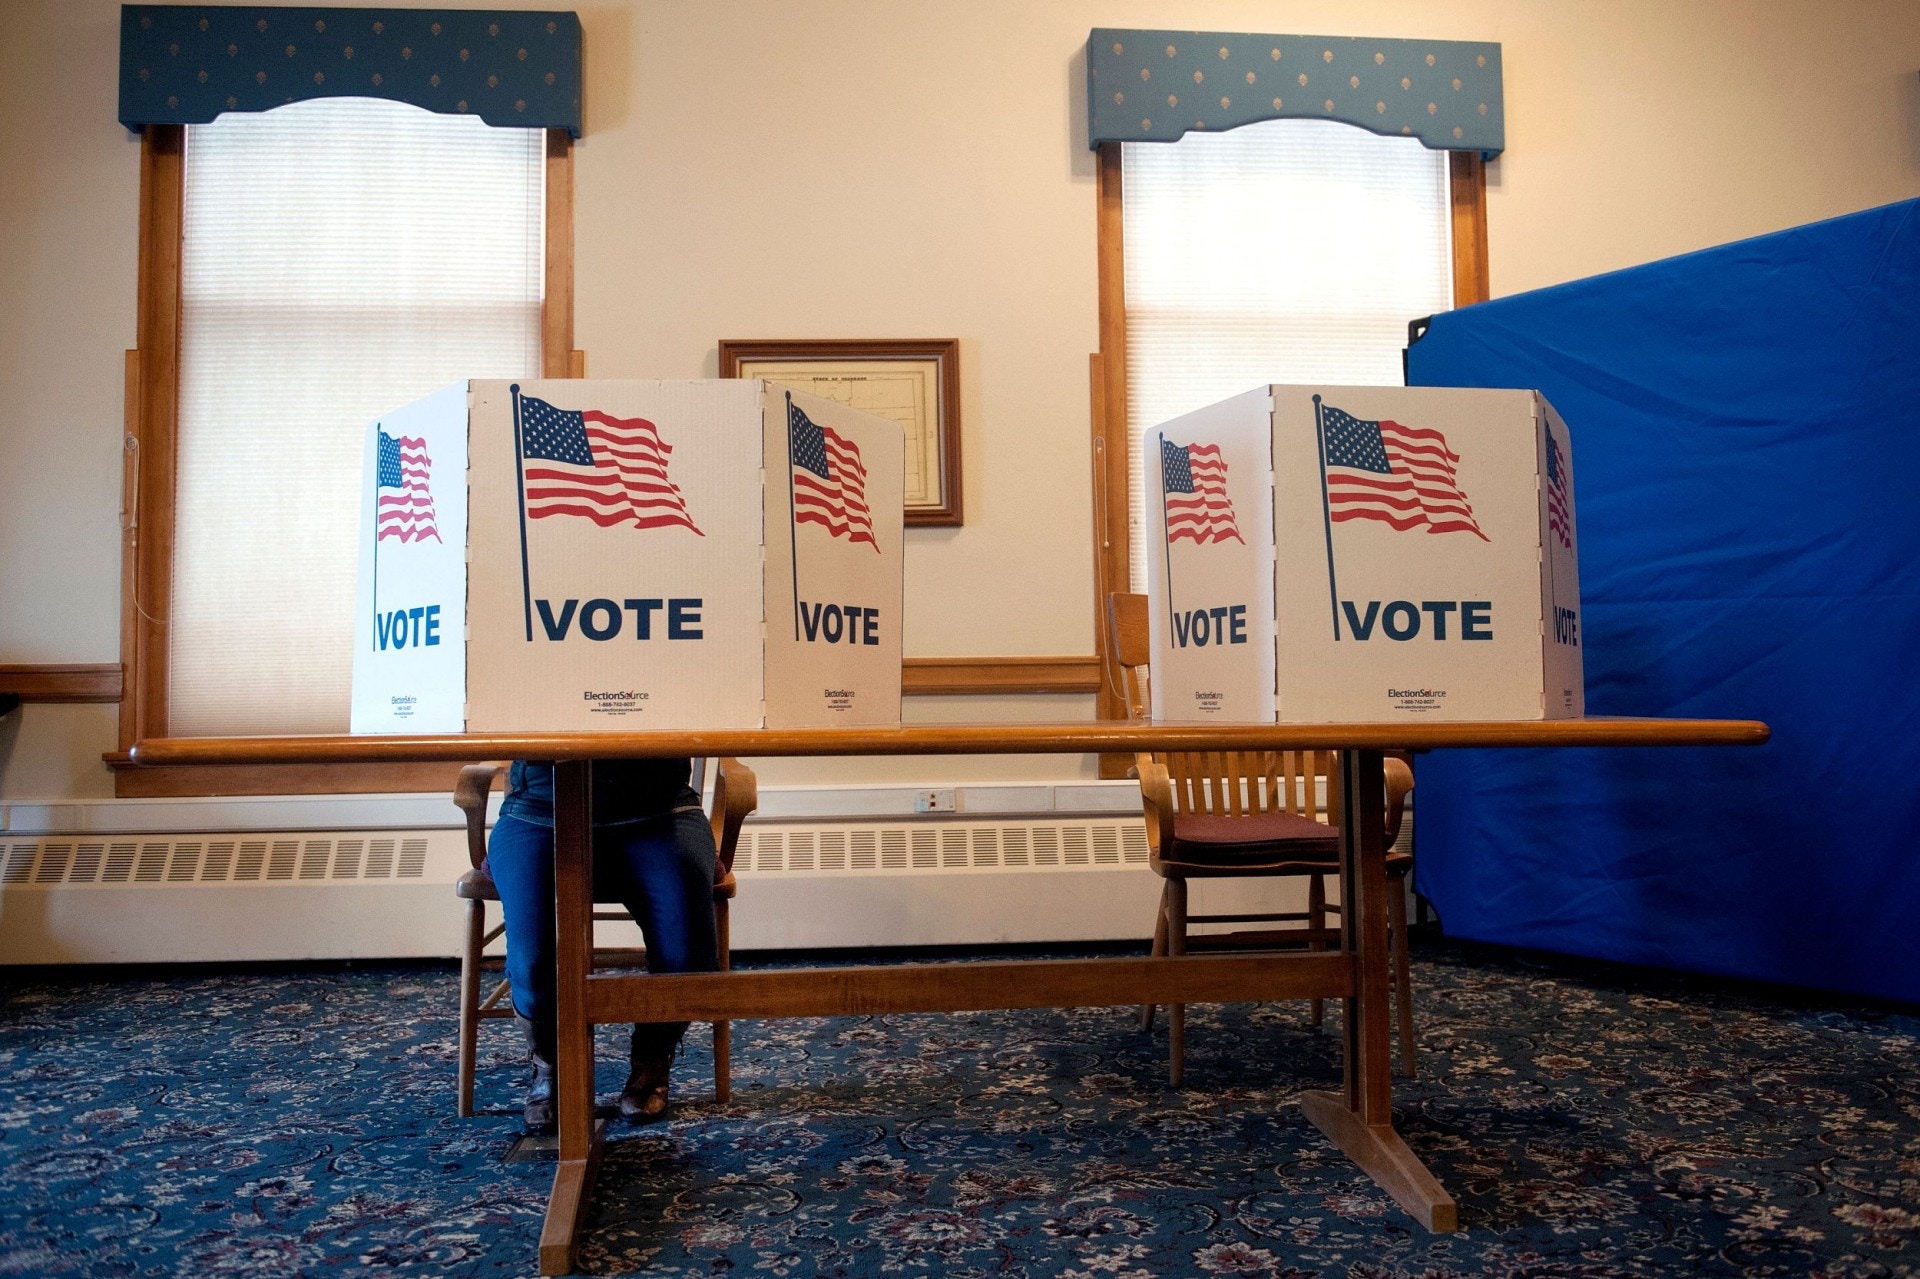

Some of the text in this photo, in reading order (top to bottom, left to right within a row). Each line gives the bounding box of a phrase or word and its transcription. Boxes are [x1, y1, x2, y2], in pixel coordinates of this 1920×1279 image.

[377, 604, 441, 651] VOTE
[534, 598, 704, 642] VOTE
[799, 601, 880, 646] VOTE
[1174, 604, 1247, 648] VOTE
[1341, 600, 1493, 641] VOTE
[1554, 606, 1577, 647] VOTE
